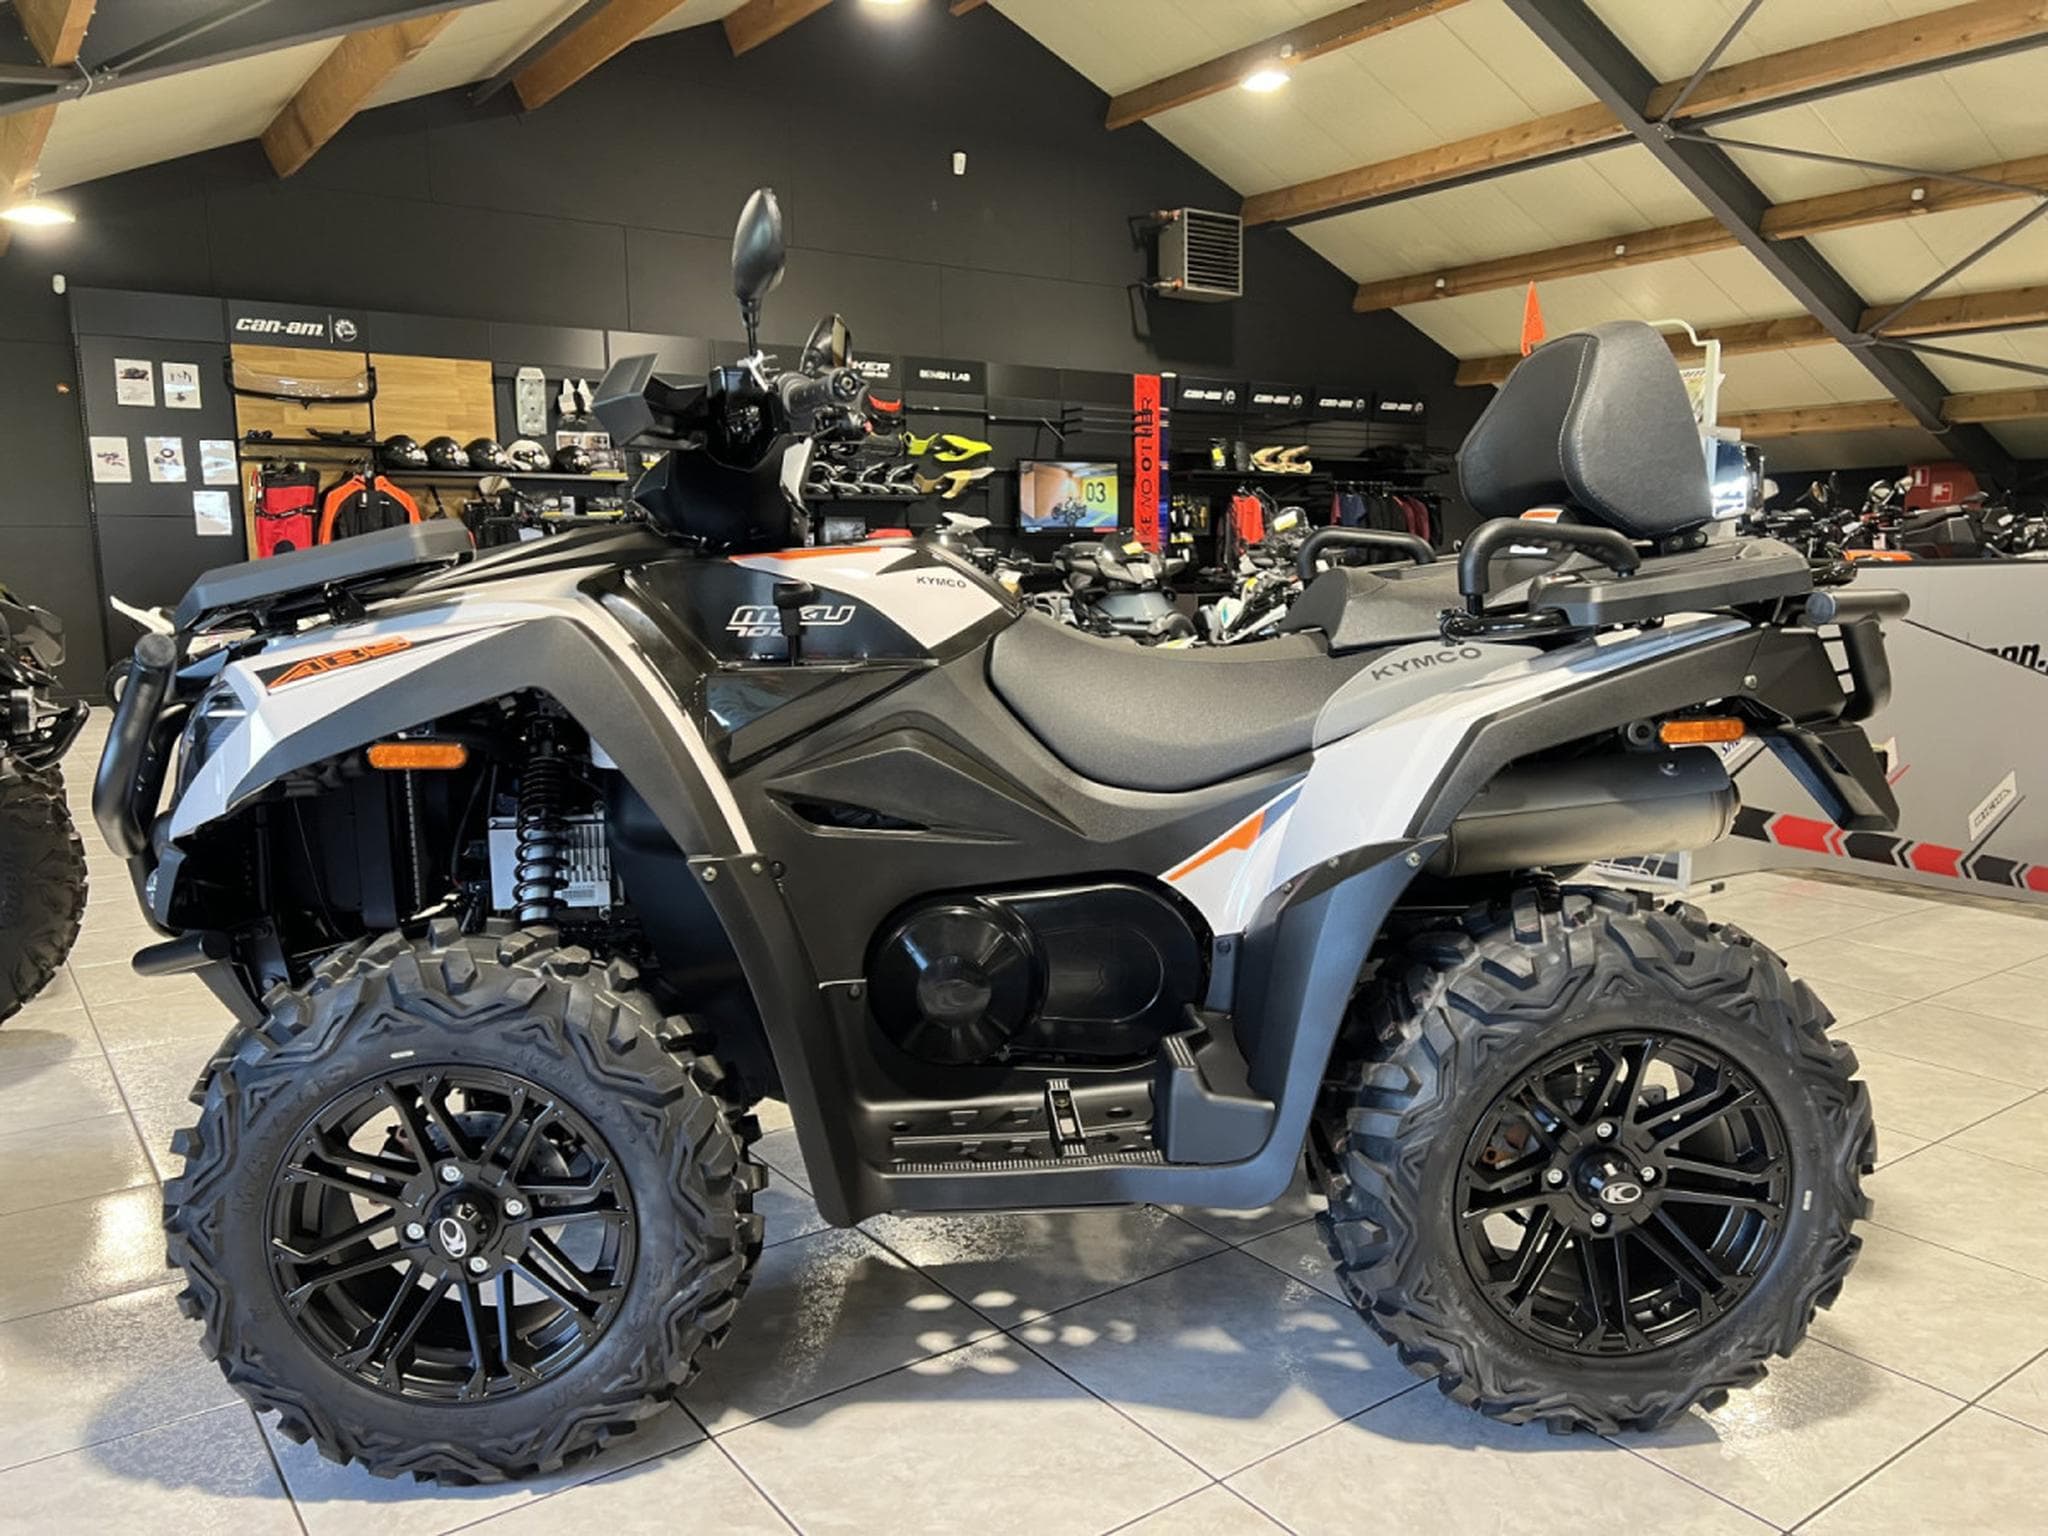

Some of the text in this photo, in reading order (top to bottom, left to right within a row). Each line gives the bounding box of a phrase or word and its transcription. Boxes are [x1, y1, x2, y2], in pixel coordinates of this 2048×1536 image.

[235, 318, 324, 336] can-am
[1086, 482, 1106, 503] 03
[1141, 478, 1153, 508] NO
[1141, 515, 1153, 547] IKE
[915, 575, 967, 589] KYMCO
[1371, 647, 1482, 681] KYMCO
